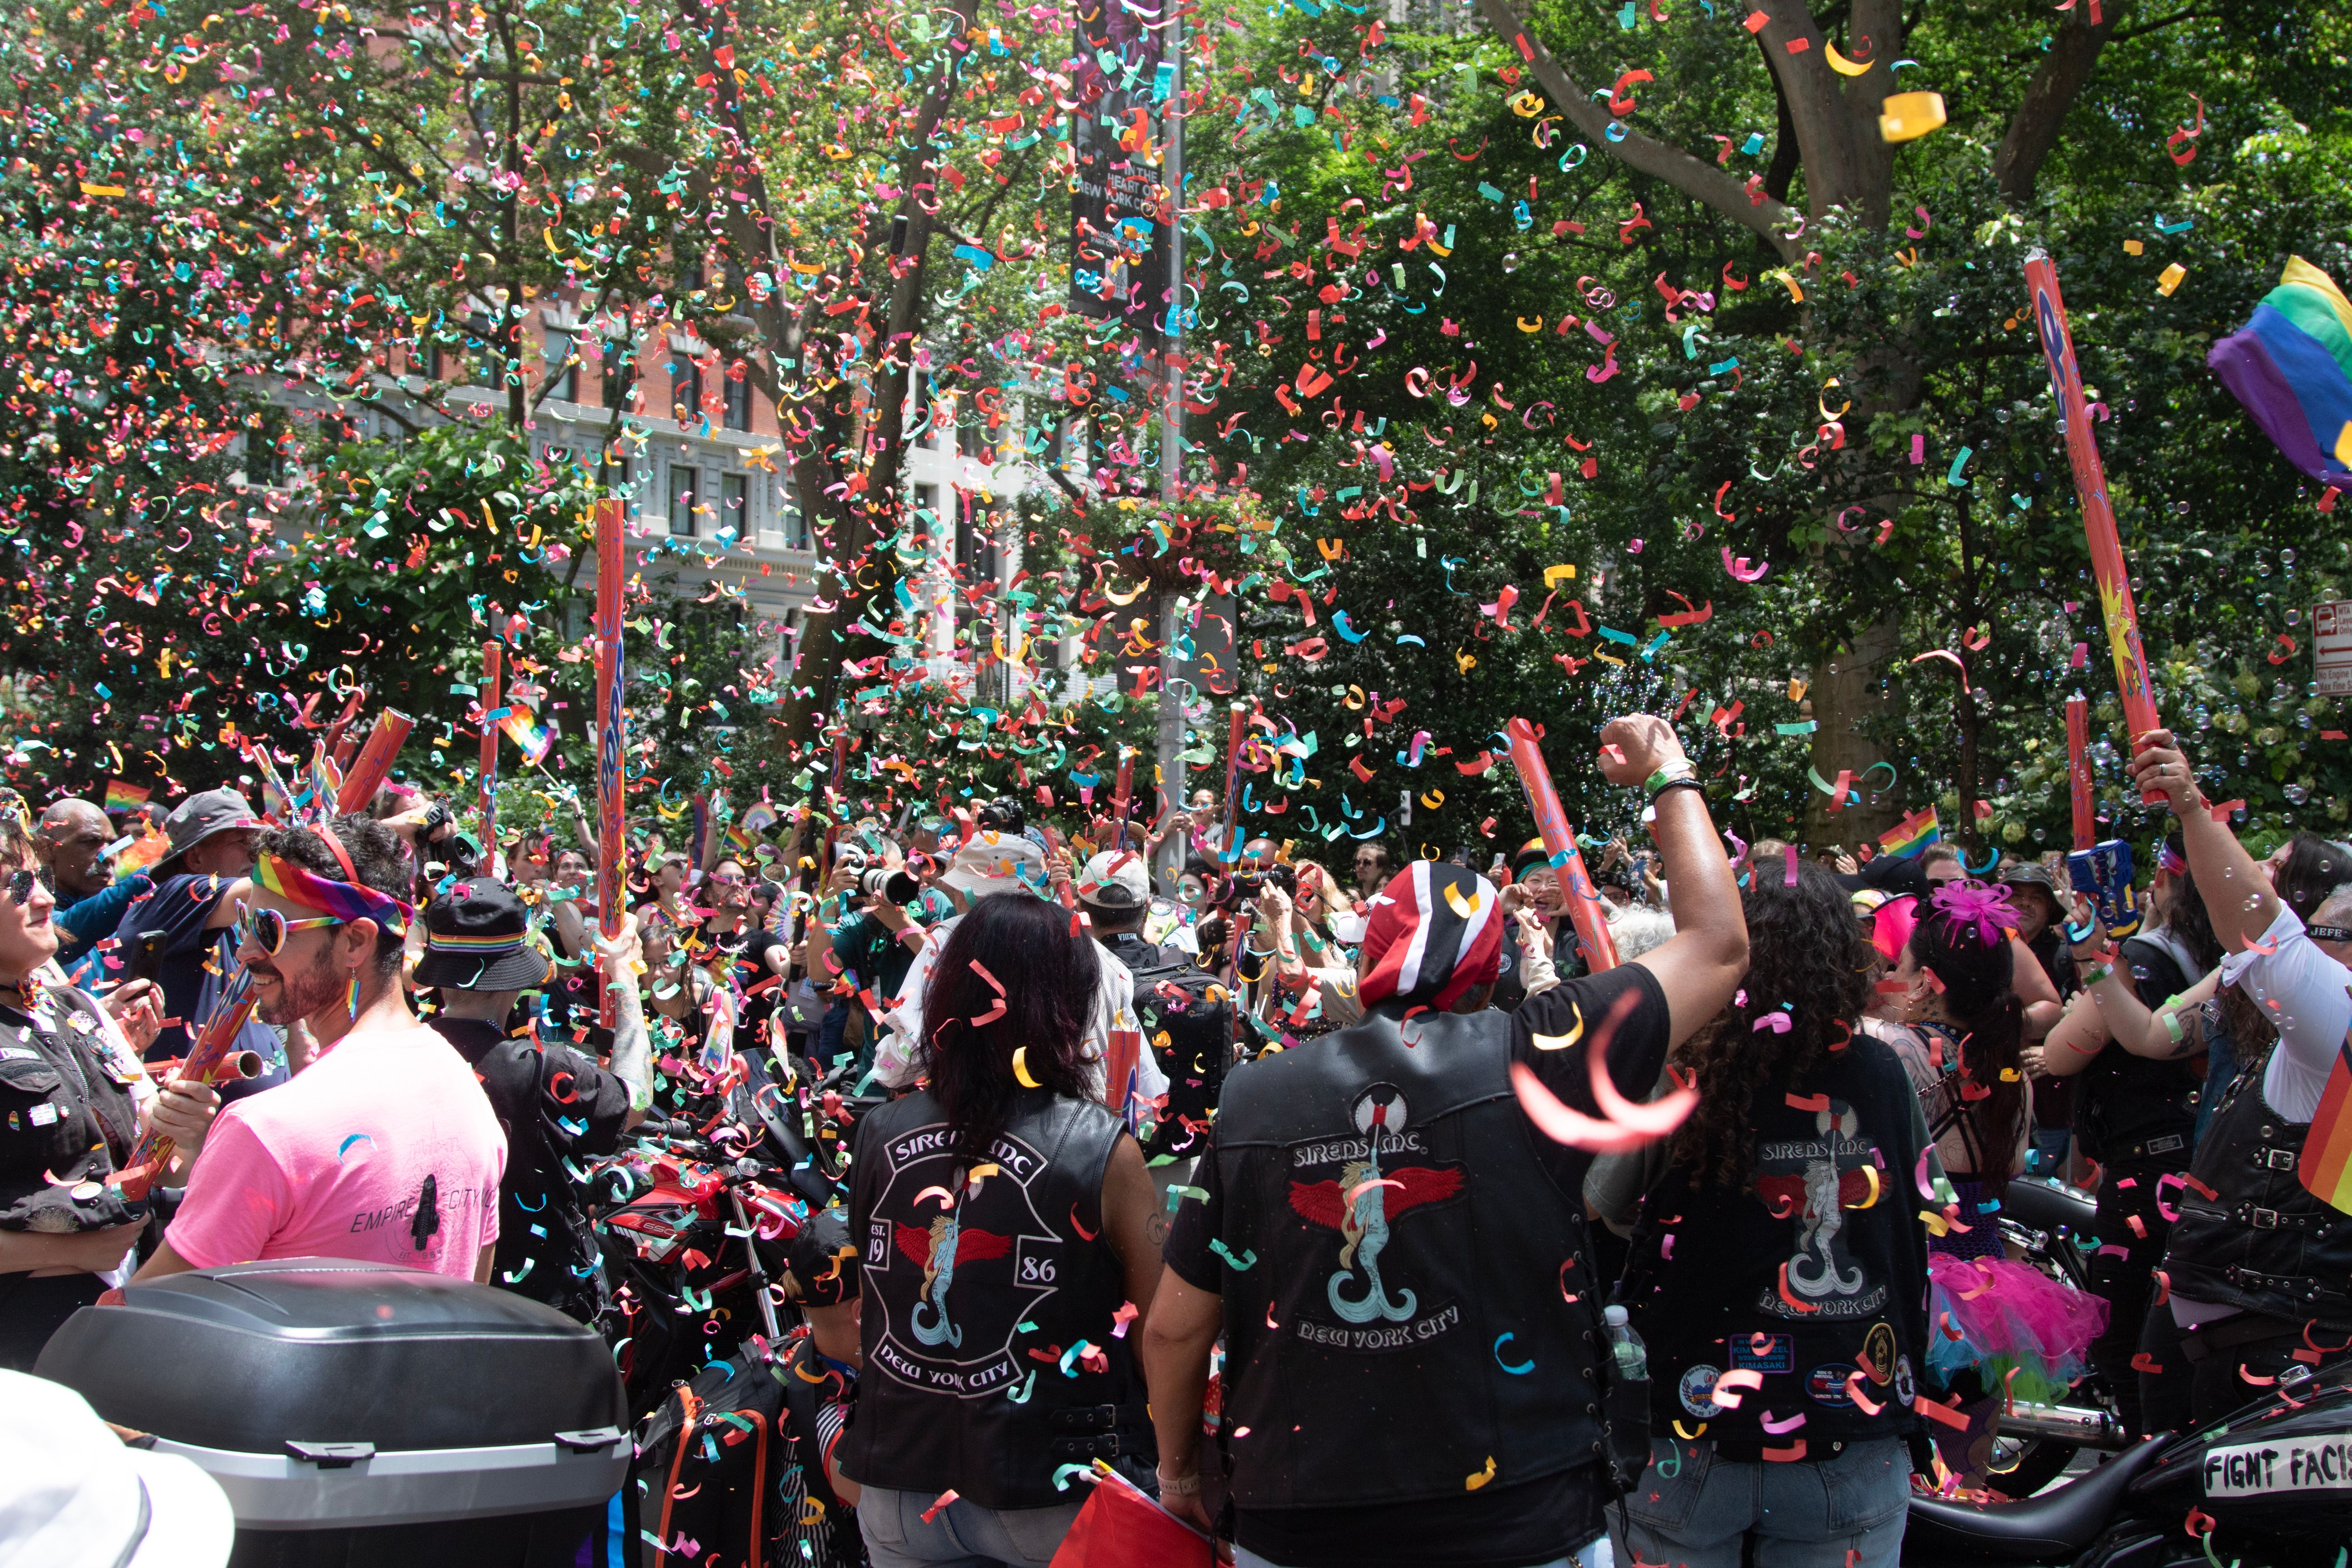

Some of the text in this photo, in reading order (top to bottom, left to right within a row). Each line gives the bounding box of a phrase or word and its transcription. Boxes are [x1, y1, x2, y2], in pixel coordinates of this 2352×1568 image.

[1108, 173, 1139, 193] HEART
[1124, 164, 1158, 183] IN THE
[1077, 180, 1101, 198] NEW
[1091, 237, 1105, 245] PARK
[2338, 607, 2351, 615] MTA
[2329, 670, 2349, 680] Engine
[2333, 682, 2345, 690] Fine
[1117, 933, 1138, 941] MEDIA
[2311, 927, 2342, 937] JEFE
[1294, 1131, 1421, 1168] SIRENS MC
[1762, 1139, 1867, 1160] SIRENS MC
[350, 1196, 417, 1233] EMPIRE
[448, 1188, 480, 1210] CITY
[871, 1224, 885, 1236] EST.
[399, 1250, 411, 1259] EST
[868, 1238, 884, 1262] 19
[1021, 1256, 1055, 1282] 86
[1860, 1285, 1885, 1311] CITY
[1297, 1305, 1459, 1349] NEW YORK CITY
[880, 1344, 921, 1379] NEW
[969, 1361, 1008, 1387] CITY
[2205, 1448, 2279, 1491] FIGHT
